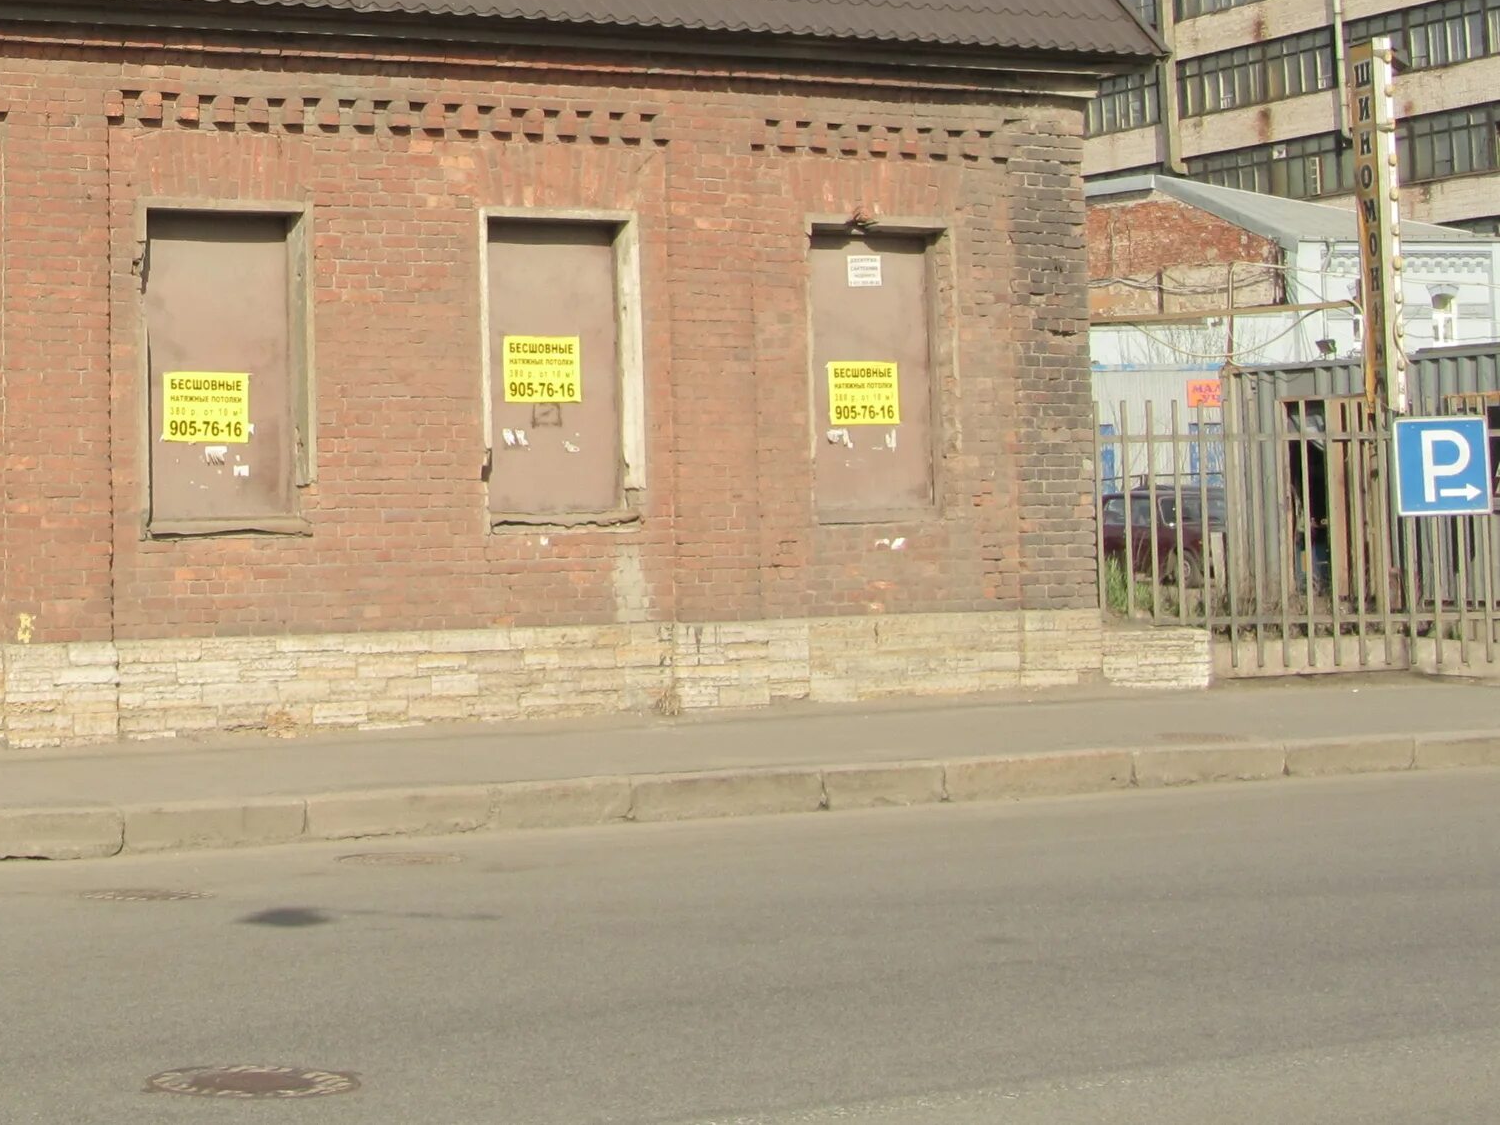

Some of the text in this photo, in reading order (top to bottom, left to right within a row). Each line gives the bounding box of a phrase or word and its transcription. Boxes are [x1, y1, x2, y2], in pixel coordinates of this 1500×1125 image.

[509, 342, 574, 354] БЕСШОВНЫЕ
[834, 368, 892, 378] БЕСШОВНЫЕ
[170, 379, 242, 391] БЕСШОВНЫЕ
[509, 382, 575, 397] 905-76-16
[170, 395, 209, 403] НАТЯЖНЫЕ
[835, 405, 895, 420] 905-76-16
[169, 420, 242, 437] 905-76-16
[1421, 429, 1470, 503] P
